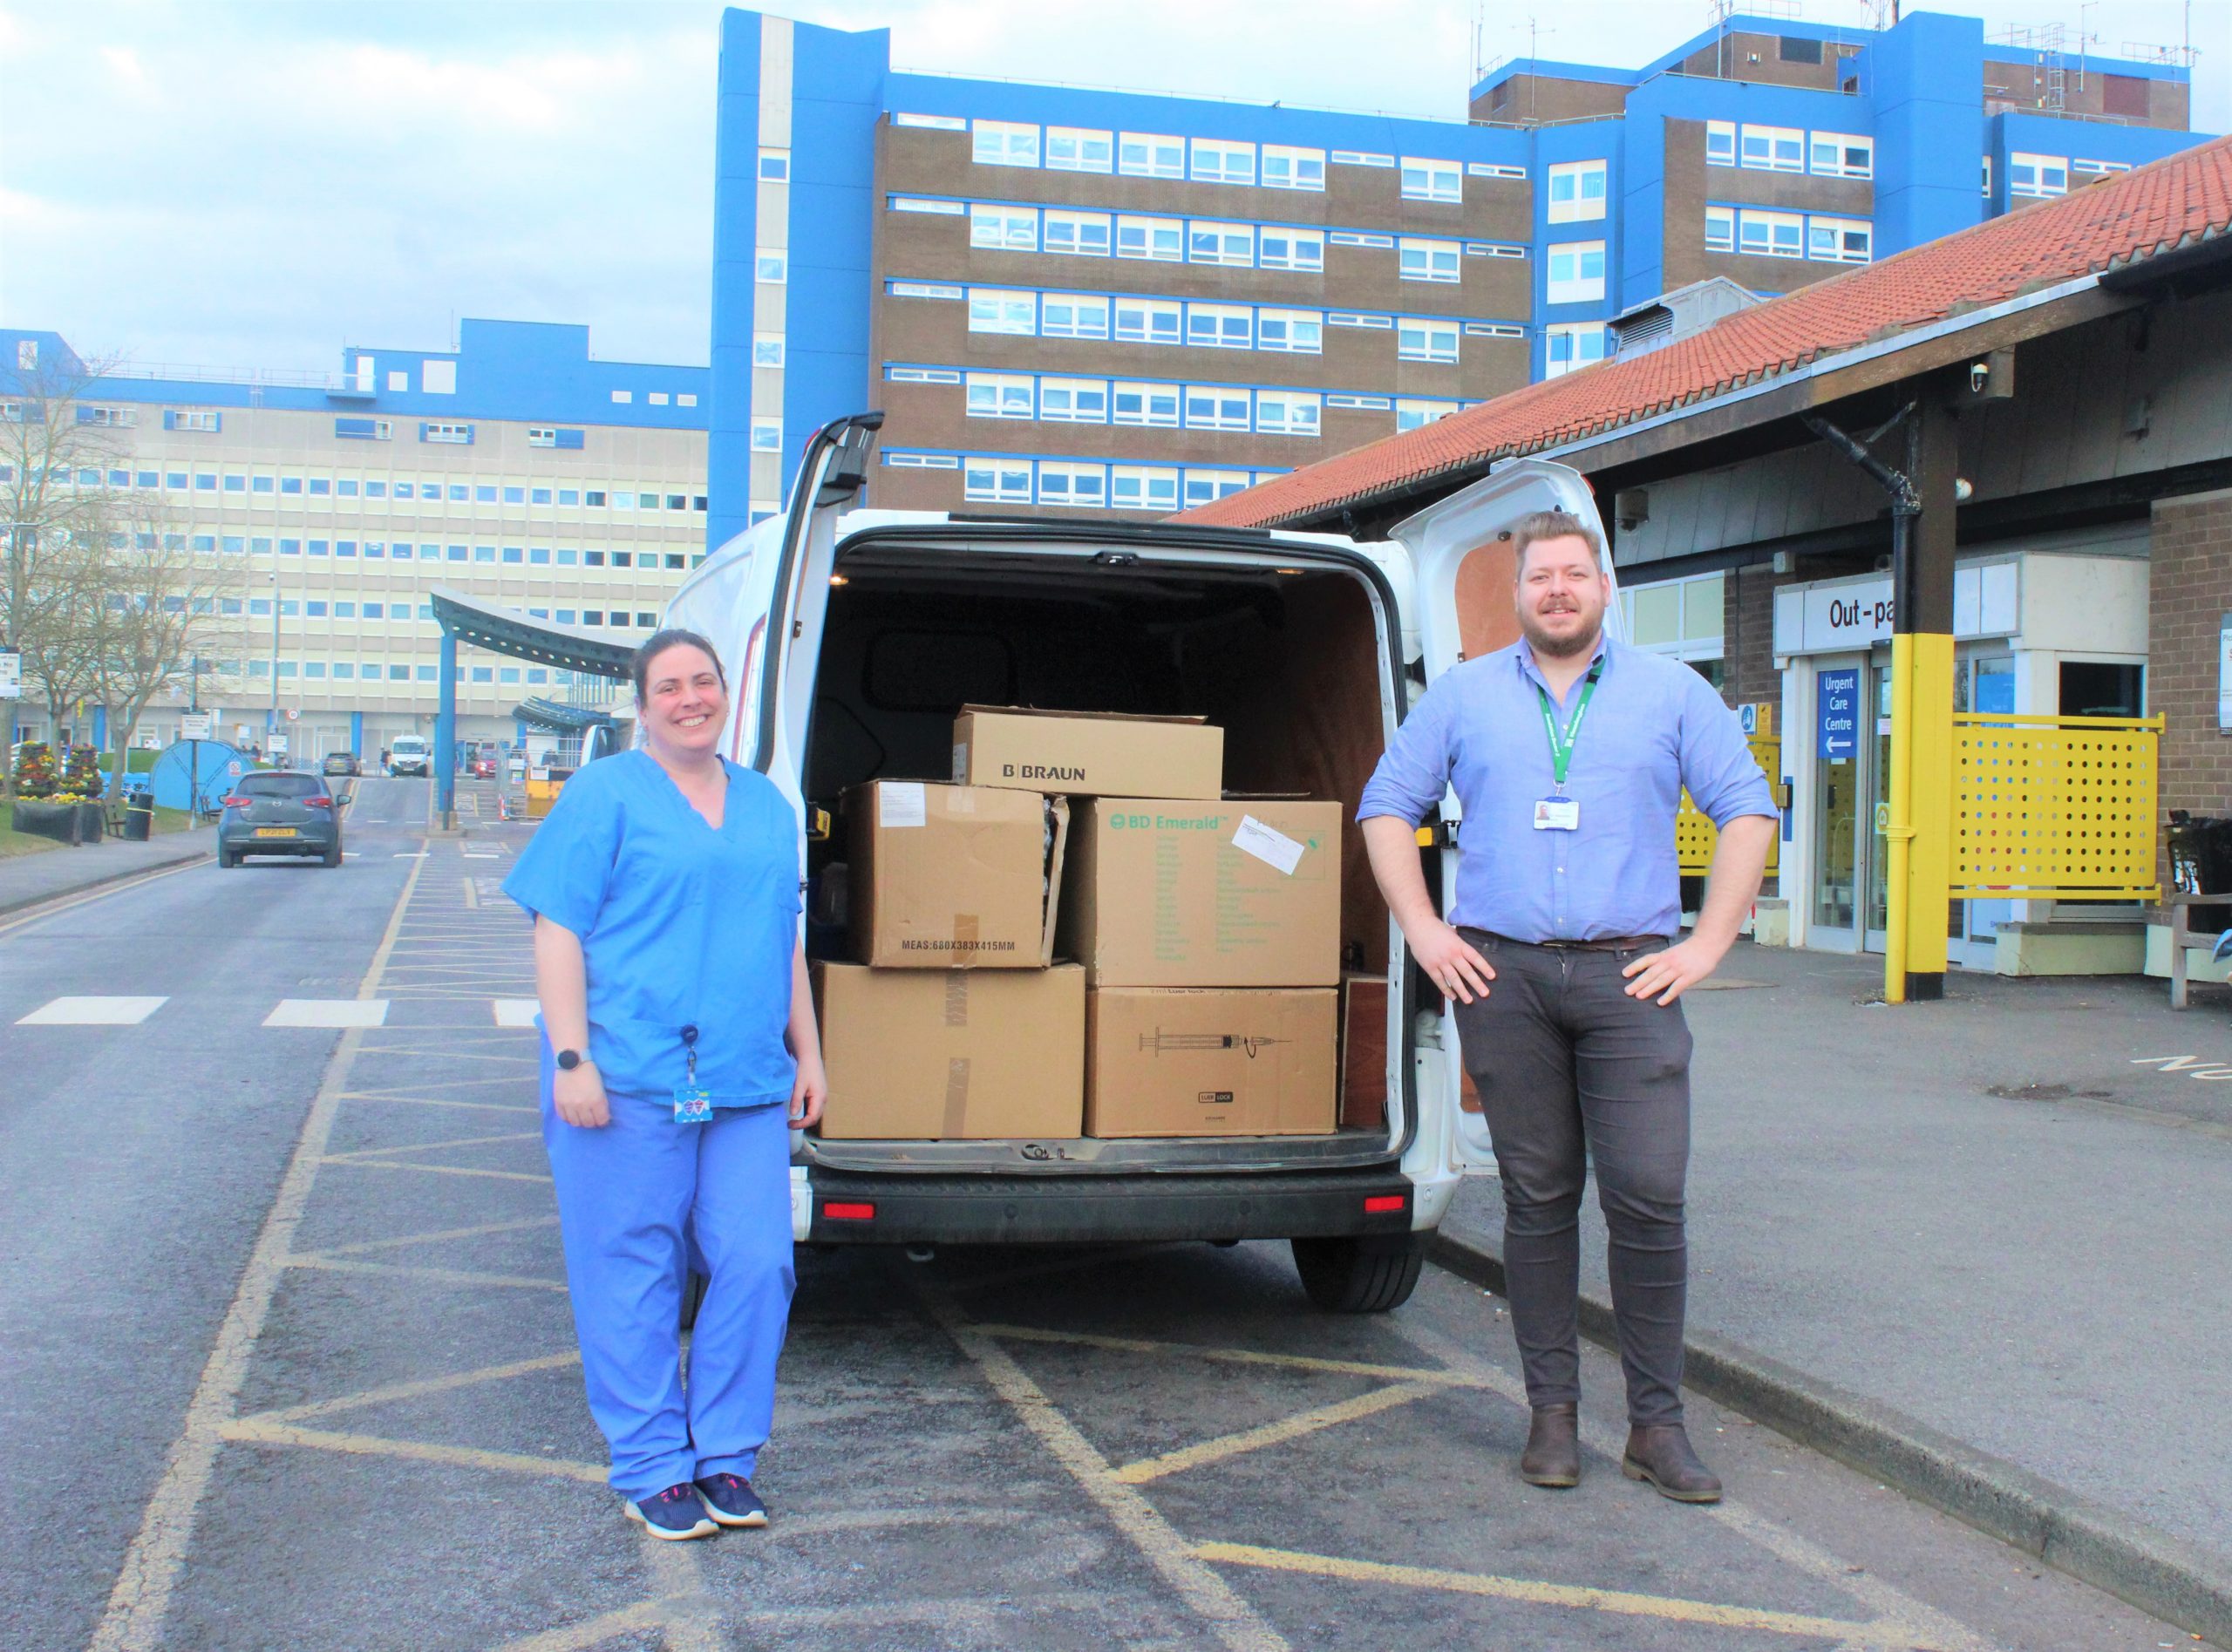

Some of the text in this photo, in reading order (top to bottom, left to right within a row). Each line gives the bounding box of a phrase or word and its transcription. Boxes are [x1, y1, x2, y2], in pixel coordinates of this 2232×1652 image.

[1830, 599, 1895, 629] Out-pa
[1825, 676, 1854, 693] Urgent
[1829, 697, 1848, 710] Care
[1825, 717, 1852, 731] Centre
[1021, 765, 1085, 781] BRAUN
[1128, 815, 1151, 829] BD
[902, 940, 1016, 951] MEAS:680X383X415MM
